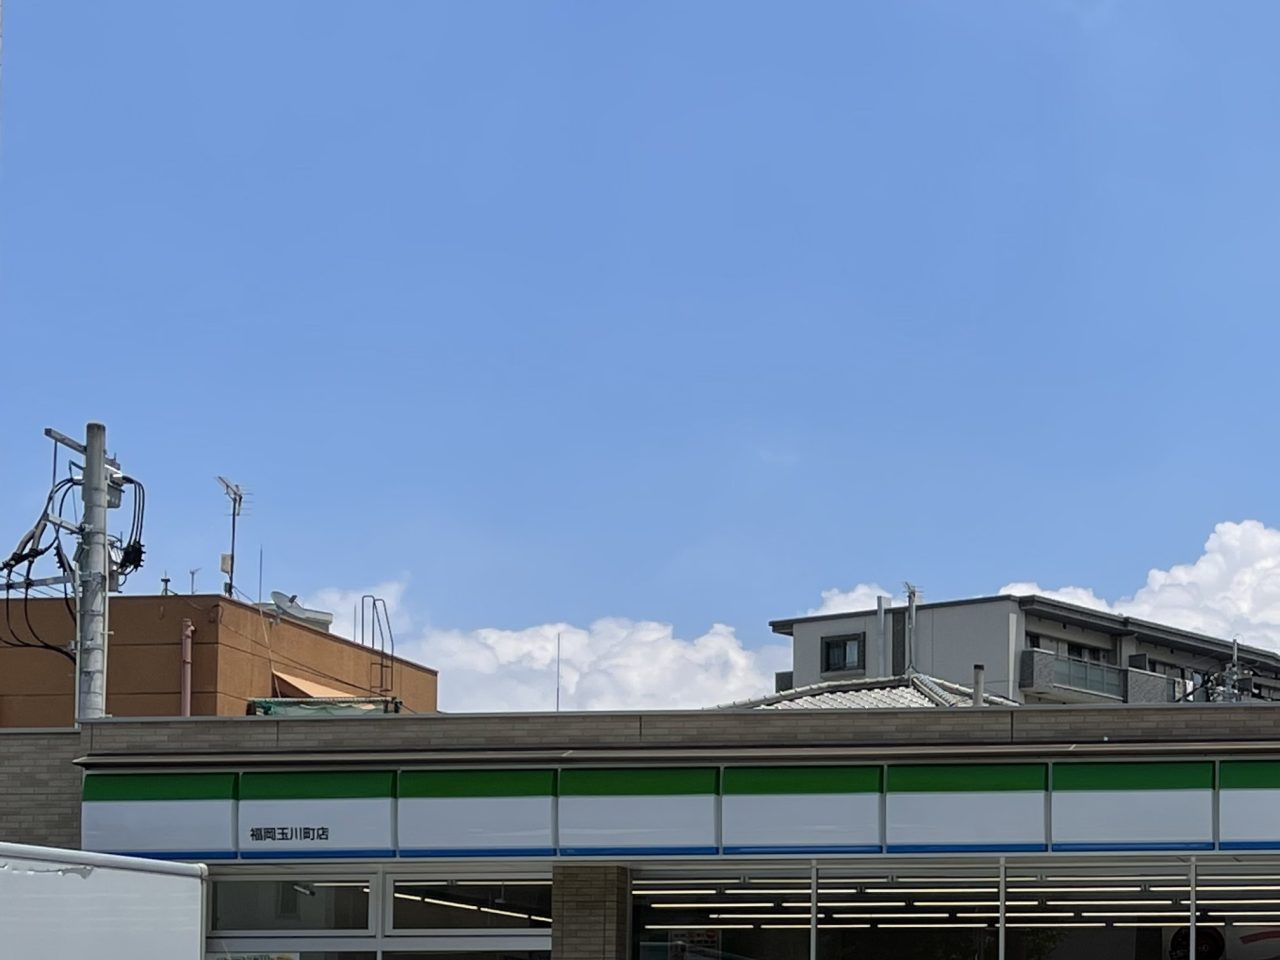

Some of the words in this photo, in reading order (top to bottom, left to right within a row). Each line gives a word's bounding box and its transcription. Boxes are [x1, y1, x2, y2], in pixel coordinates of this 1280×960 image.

[250, 826, 329, 841] 福岡玉川町店
